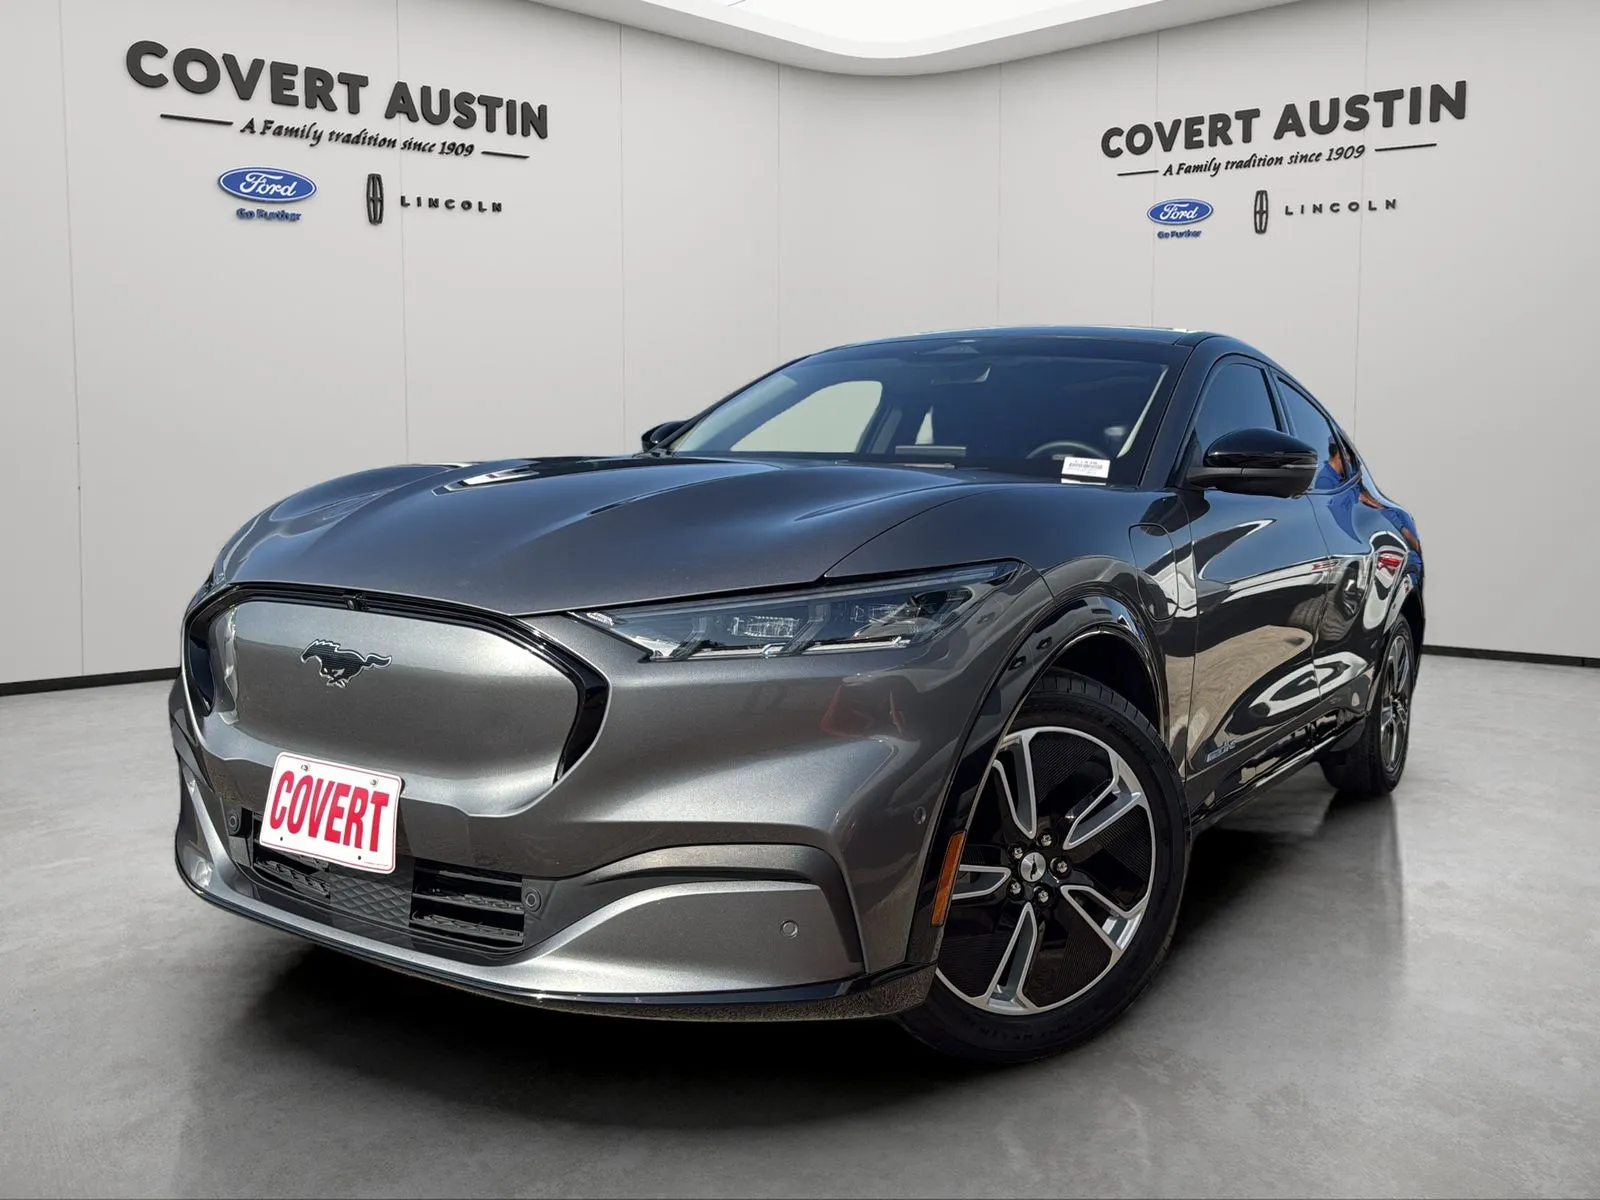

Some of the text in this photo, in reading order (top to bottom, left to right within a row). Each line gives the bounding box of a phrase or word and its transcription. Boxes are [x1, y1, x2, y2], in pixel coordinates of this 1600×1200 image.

[126, 40, 548, 140] COVERT AUSTIN
[1101, 80, 1467, 159] COVERT AUSTIN
[240, 117, 475, 157] A Family tradition since 1909
[1163, 144, 1366, 177] A Family tradition since 1909
[239, 172, 298, 197] Ford
[400, 195, 502, 213] LINCOLN
[1159, 203, 1199, 220] Ford
[1285, 198, 1397, 216] LINCOLN
[270, 770, 390, 852] COVERT
